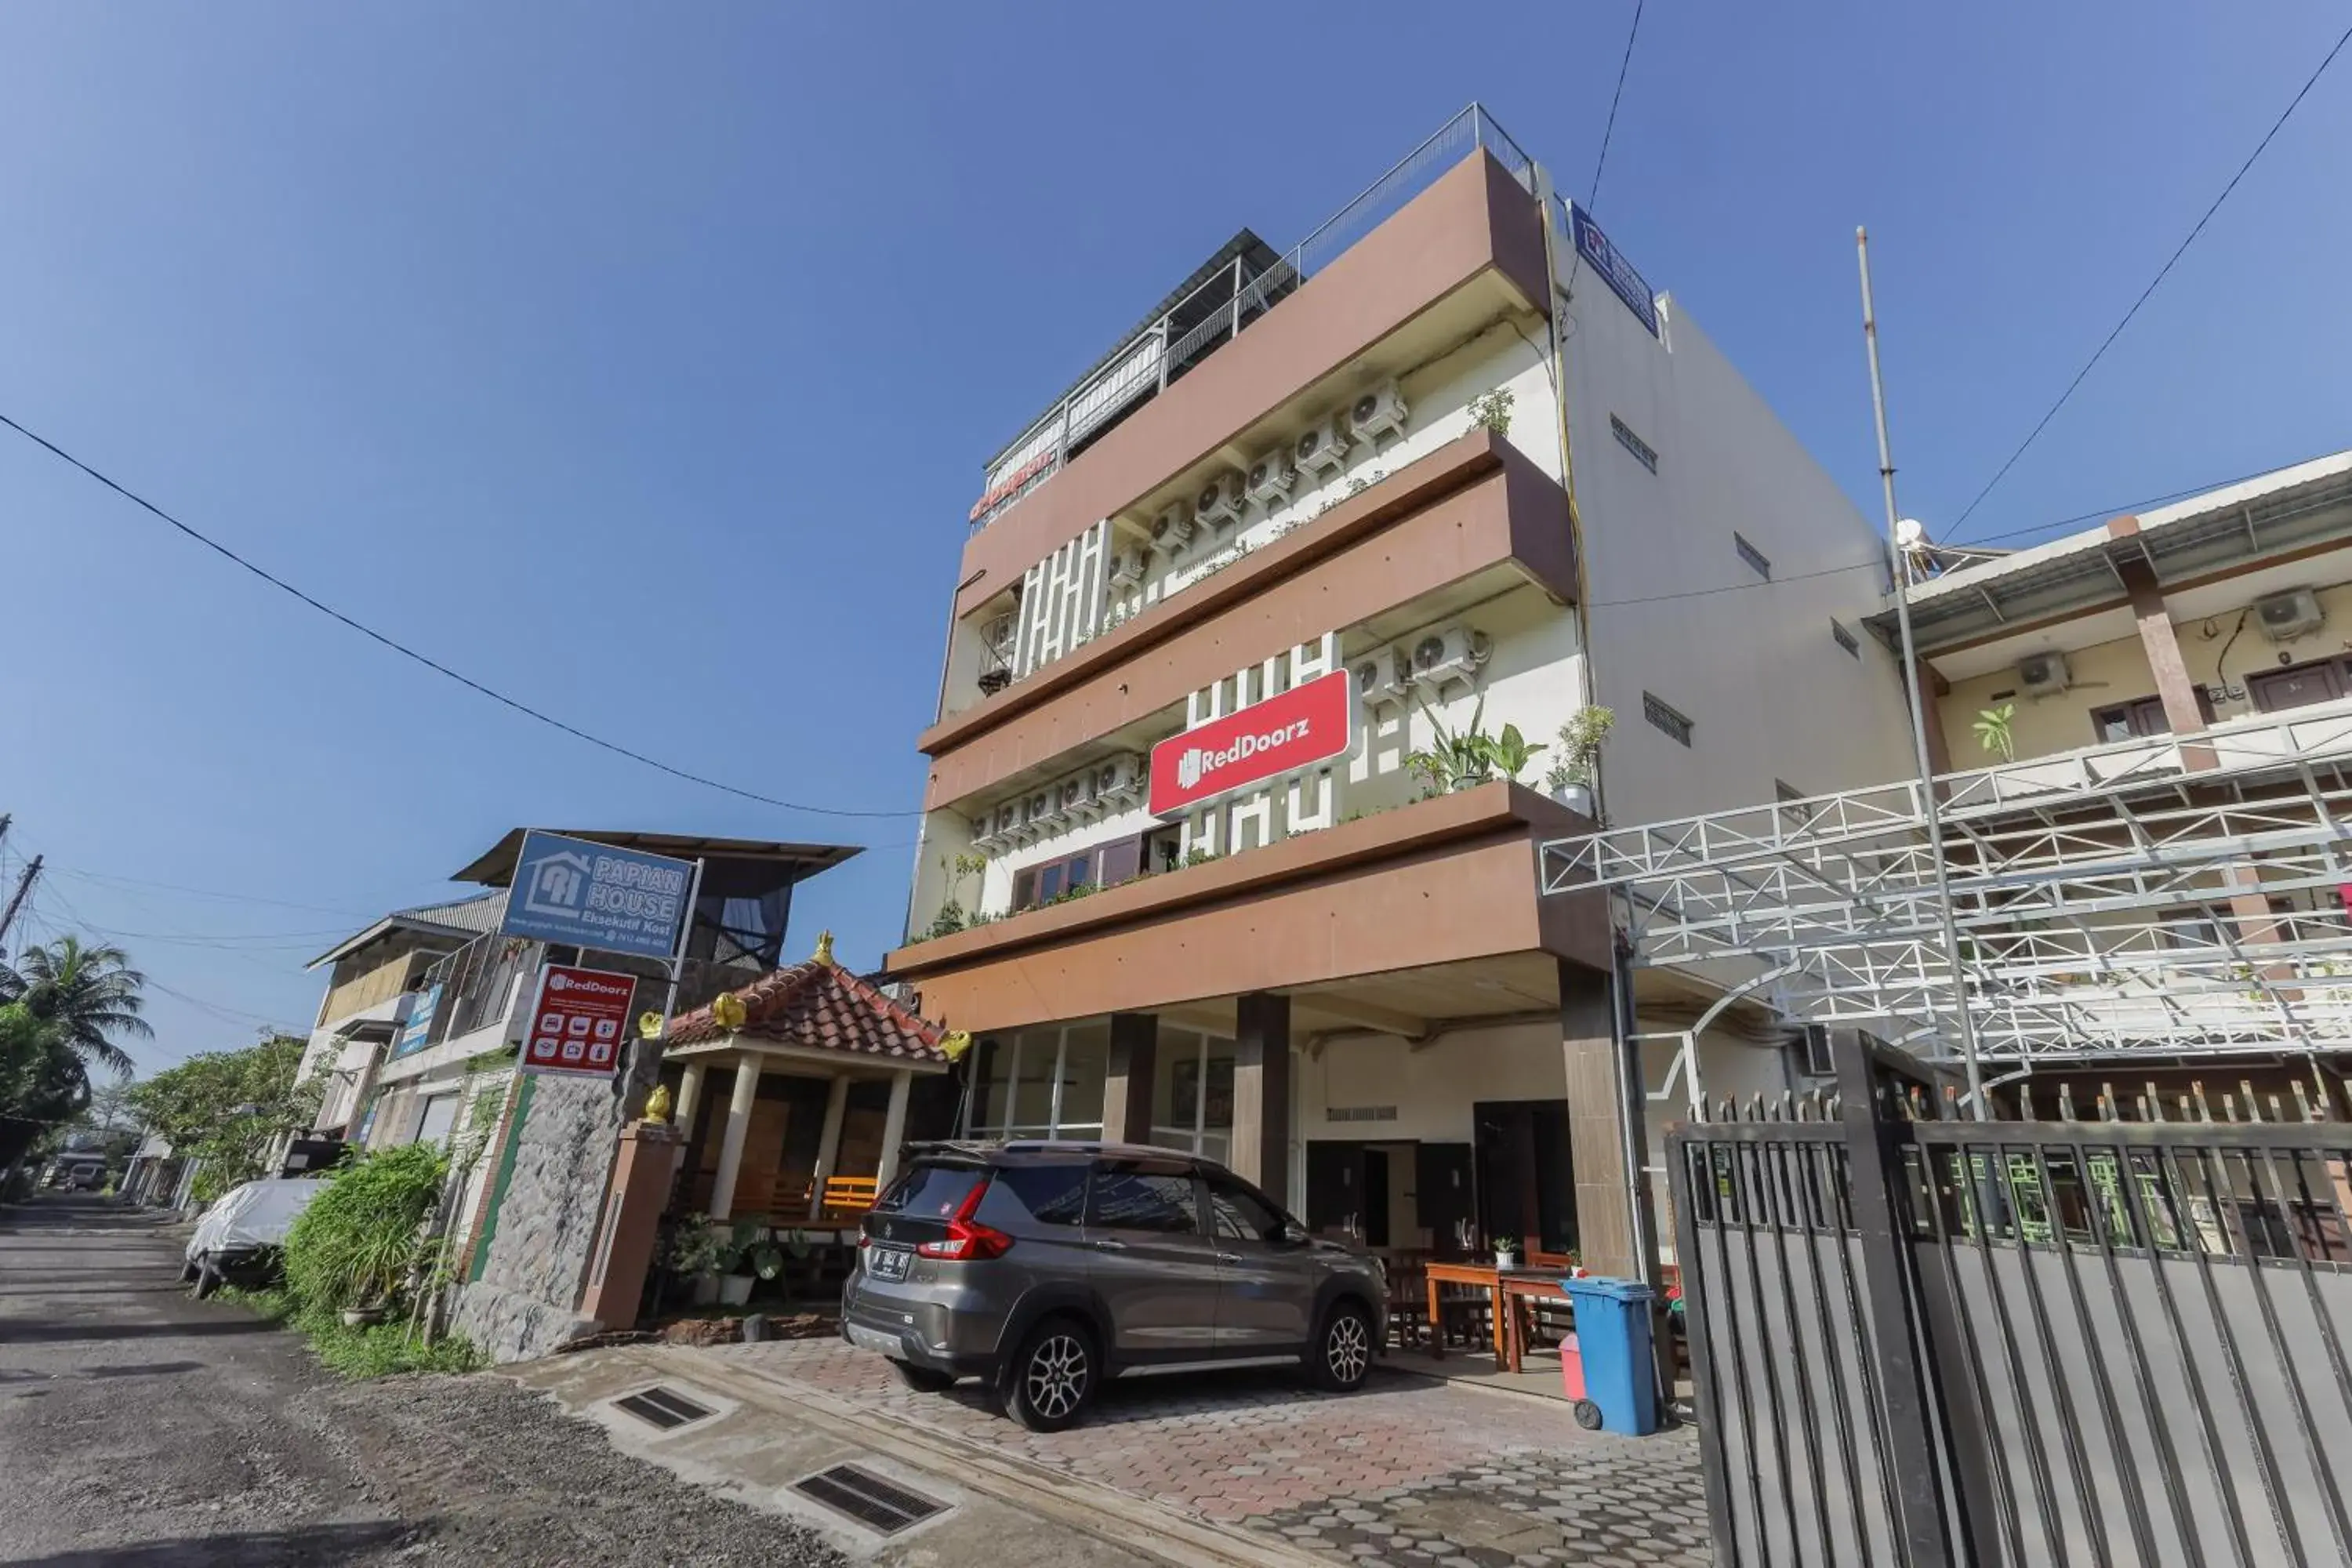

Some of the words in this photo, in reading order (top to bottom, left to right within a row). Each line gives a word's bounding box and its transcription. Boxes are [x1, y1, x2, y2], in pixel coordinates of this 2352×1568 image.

[1202, 718, 1309, 774] RedDoorz
[586, 884, 677, 921] HOUSE
[564, 978, 628, 996] RedDoorz
